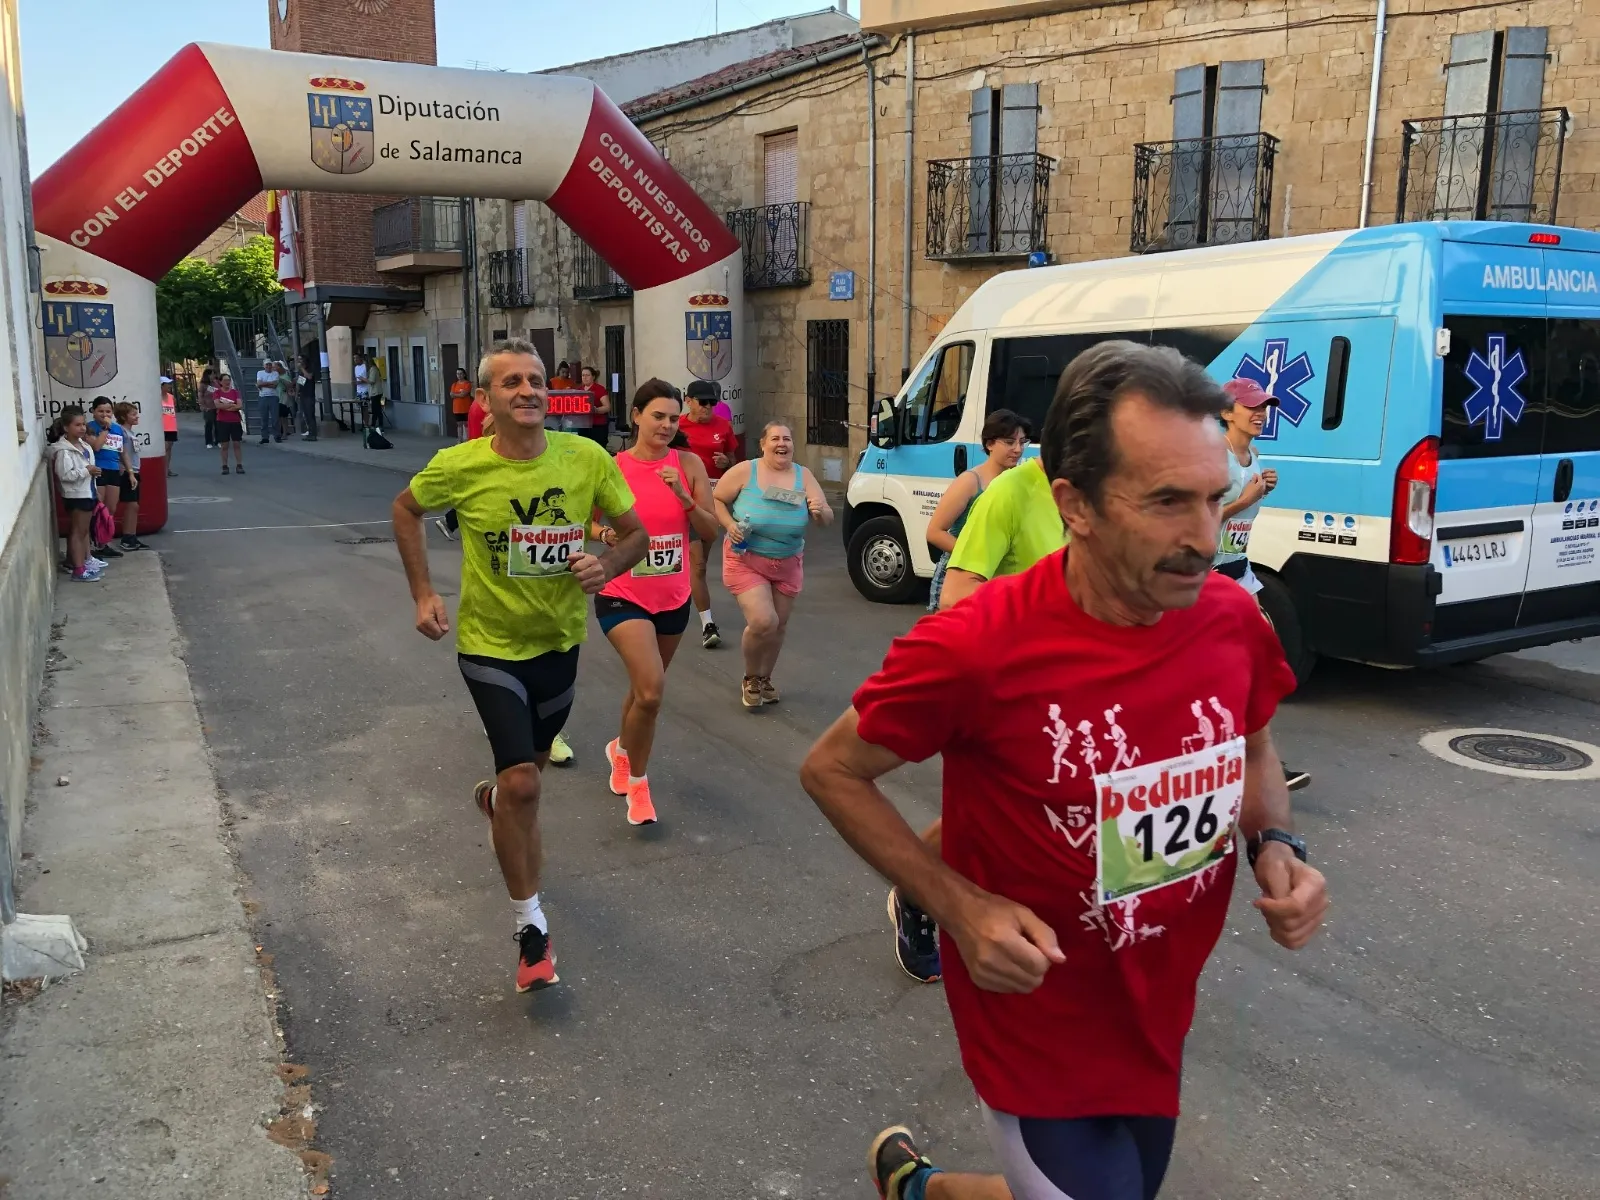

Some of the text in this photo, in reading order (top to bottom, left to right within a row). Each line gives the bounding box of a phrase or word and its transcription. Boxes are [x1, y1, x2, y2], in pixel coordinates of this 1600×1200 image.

[378, 94, 500, 121] Diputación
[380, 140, 522, 165] de Salamanca
[70, 106, 236, 248] CON EL DEPORTE
[600, 132, 711, 253] CON NUESTROS
[588, 156, 691, 263] DEPORTISTAS
[1482, 264, 1598, 293] AMBULANCIA
[876, 458, 885, 470] 66
[511, 528, 584, 545] bedunia
[649, 537, 682, 551] dunia
[526, 544, 570, 565] 140
[646, 549, 675, 567] 157
[1452, 541, 1507, 563] 4443 LRJ
[1101, 754, 1243, 822] bedunia
[1133, 794, 1218, 863] 126
